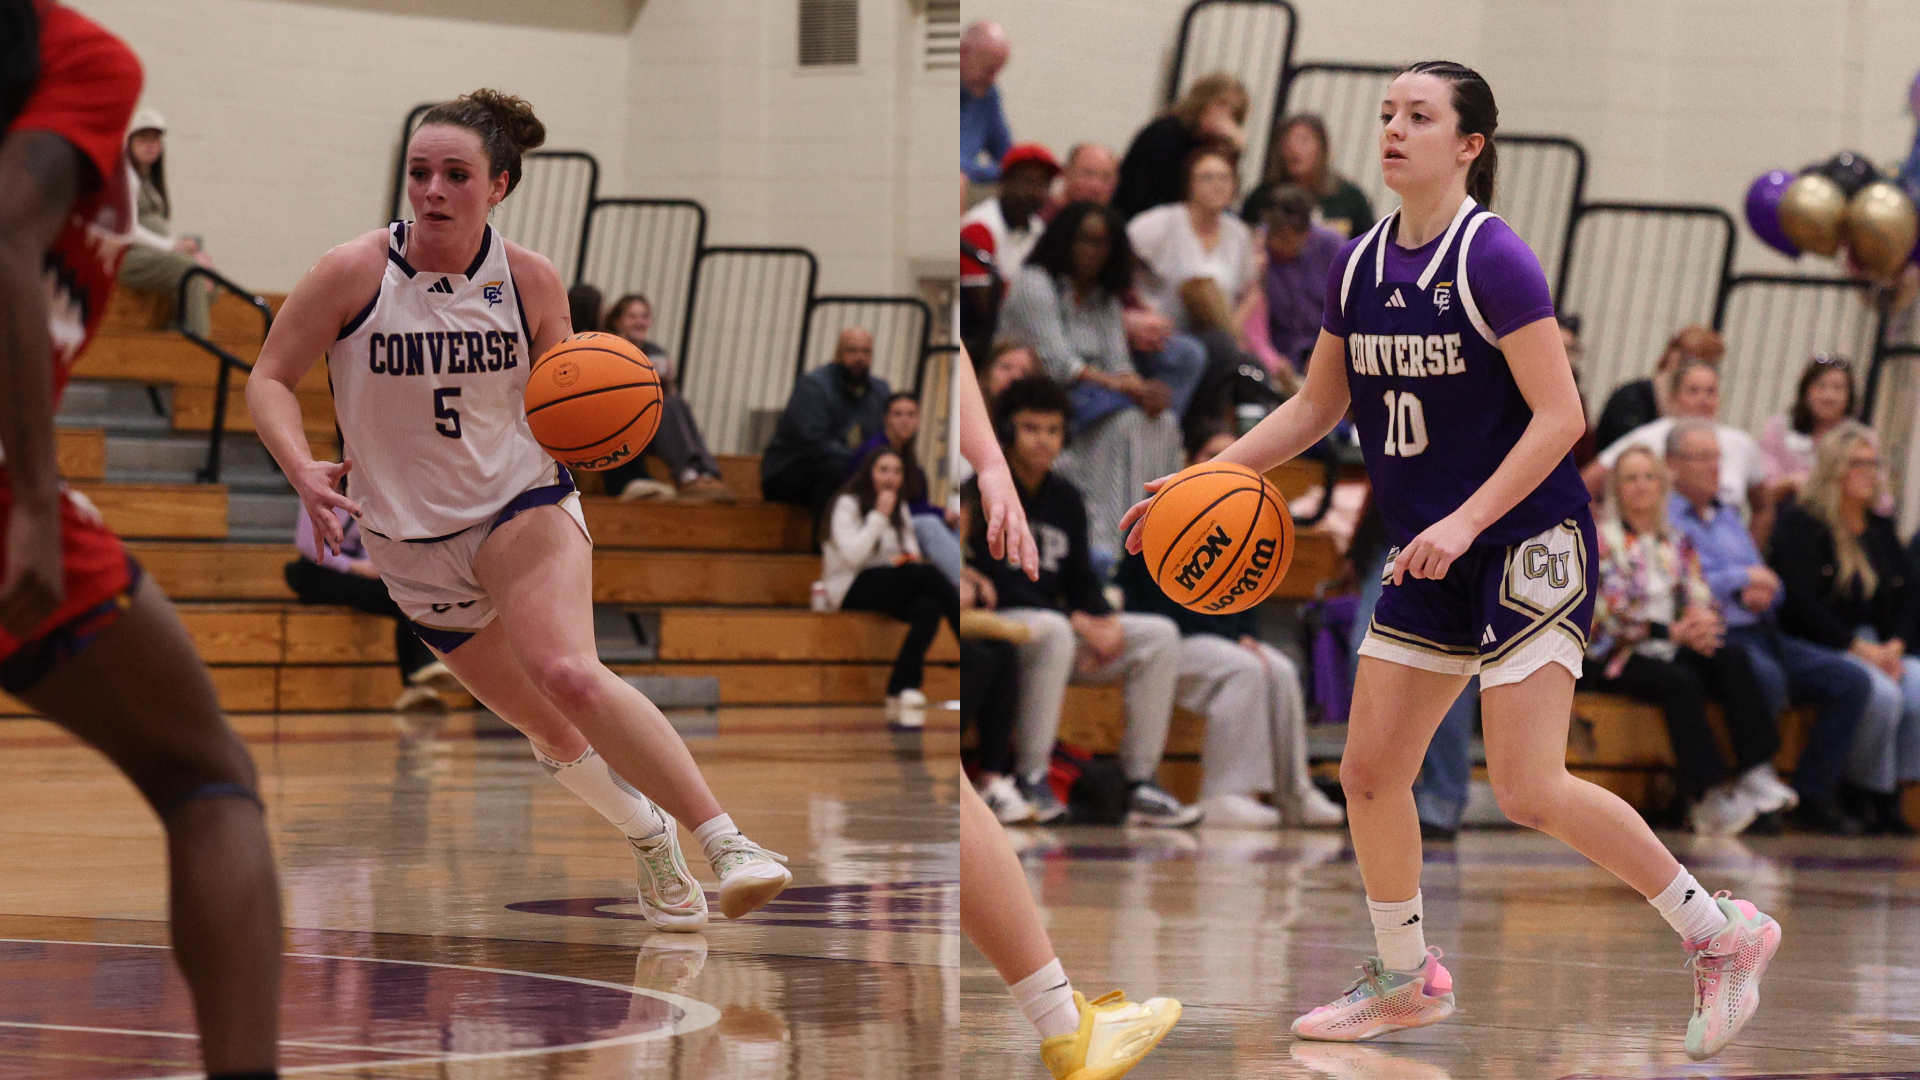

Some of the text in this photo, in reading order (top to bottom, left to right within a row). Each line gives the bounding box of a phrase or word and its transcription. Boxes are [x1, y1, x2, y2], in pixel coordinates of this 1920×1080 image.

[369, 330, 519, 376] CONVERSE
[1348, 332, 1467, 378] CONVERSE
[433, 386, 462, 439] 5
[1382, 389, 1430, 458] 10
[1174, 524, 1233, 592] NCAA
[1202, 537, 1277, 612] Wilson
[1523, 543, 1570, 589] CU
